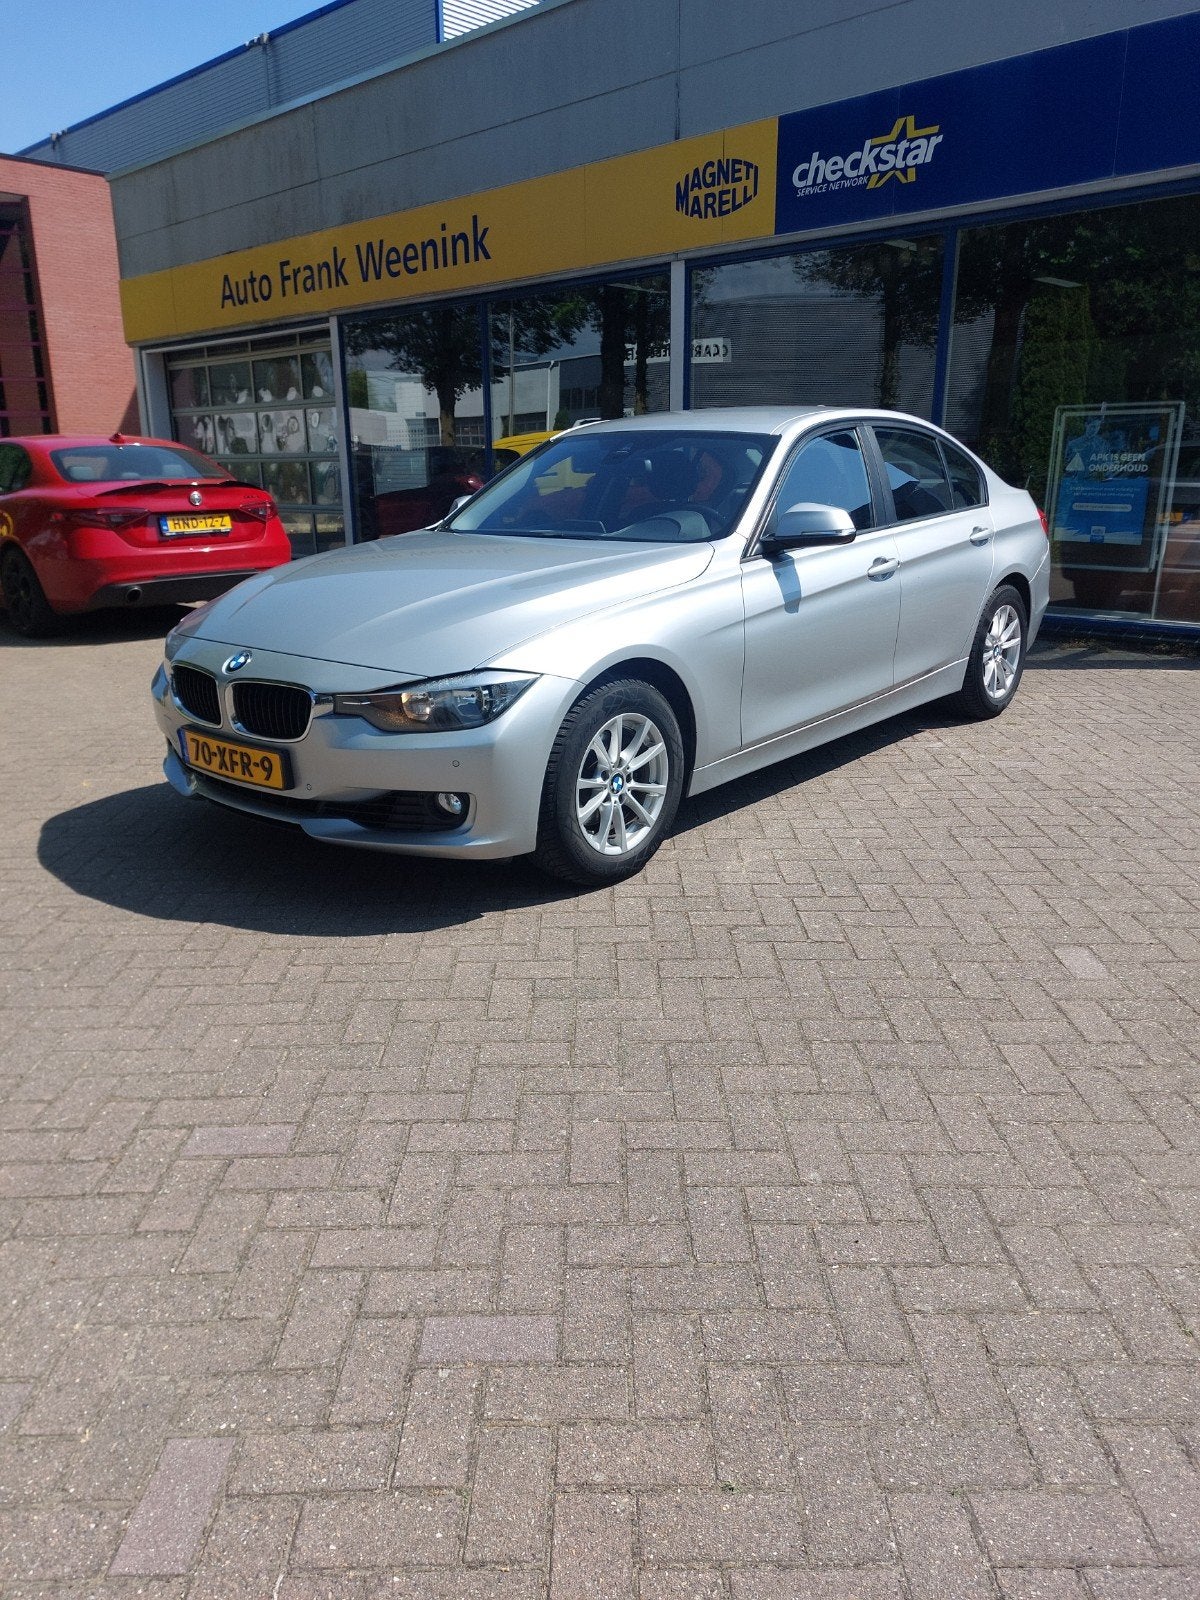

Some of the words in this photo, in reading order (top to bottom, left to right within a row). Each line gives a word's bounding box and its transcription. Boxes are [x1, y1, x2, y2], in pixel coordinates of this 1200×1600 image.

[675, 158, 759, 195] MAGNETI
[792, 134, 943, 189] checkstar
[675, 180, 759, 219] MARELLI
[796, 183, 828, 197] SERVICE
[828, 175, 870, 191] NETWORK
[220, 274, 273, 309] Auto
[279, 246, 349, 298] Frank
[355, 214, 492, 283] Weenink
[1088, 464, 1149, 473] ONDERHOUD
[190, 737, 273, 781] 70-XFR-9
